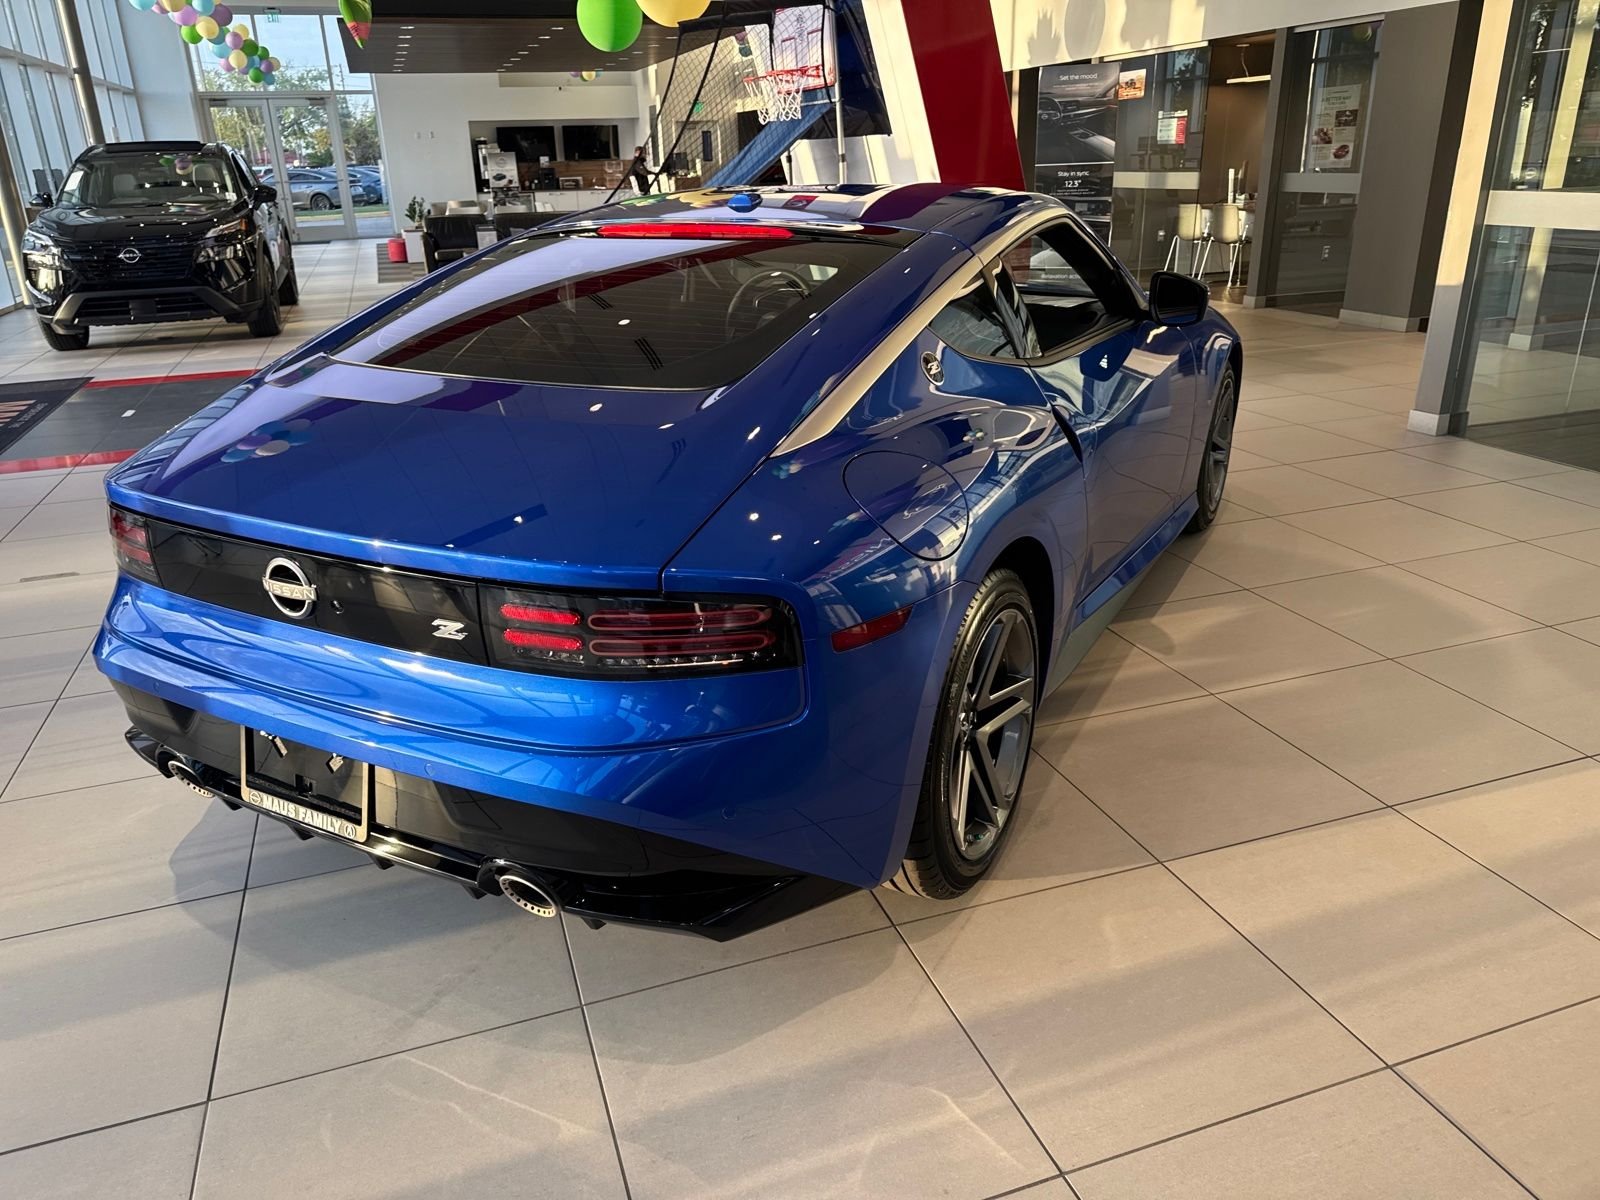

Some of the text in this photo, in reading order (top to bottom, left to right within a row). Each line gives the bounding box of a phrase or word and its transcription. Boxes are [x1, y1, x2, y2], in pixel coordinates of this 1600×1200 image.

[927, 360, 941, 375] Z
[262, 578, 317, 600] NISSAN
[431, 618, 469, 640] Z
[261, 795, 342, 834] MAUS FAMILY
